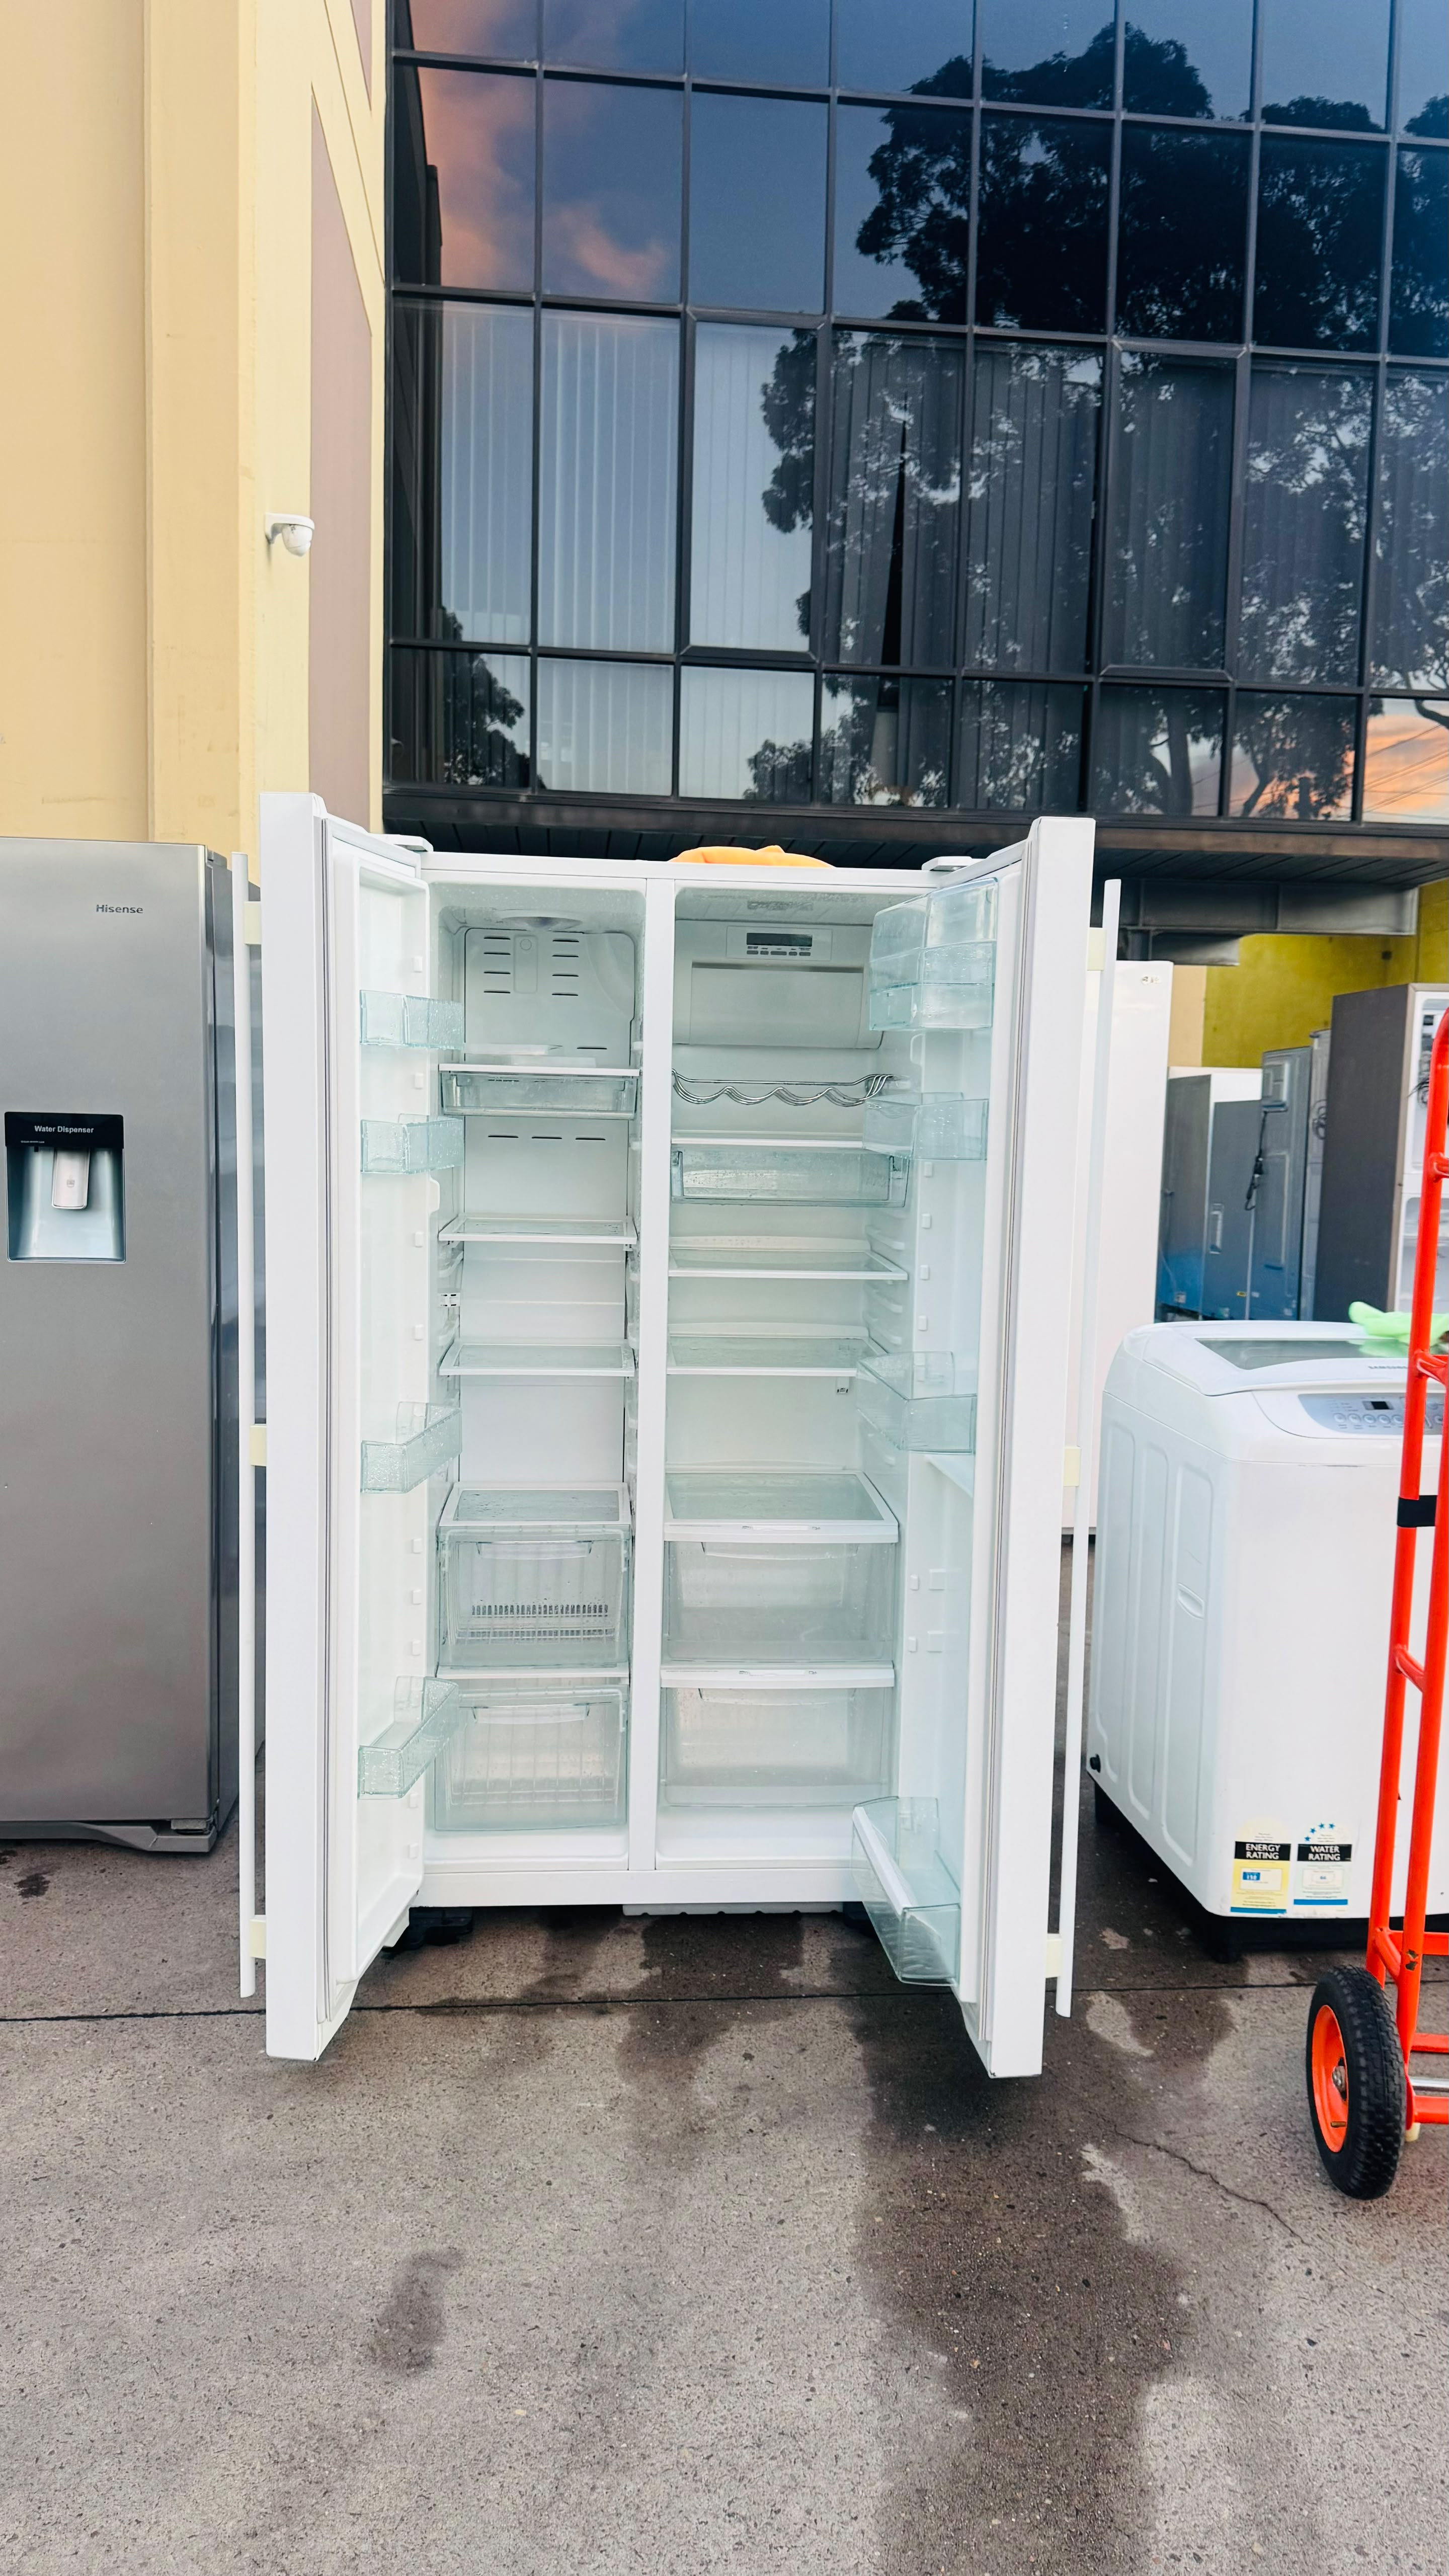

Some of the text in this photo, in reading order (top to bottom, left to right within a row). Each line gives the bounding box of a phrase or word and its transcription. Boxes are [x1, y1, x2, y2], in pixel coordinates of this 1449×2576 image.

[96, 904, 143, 914] Hisense
[57, 1125, 94, 1134] Dispenser
[1245, 1843, 1281, 1852] ENERGY
[1310, 1845, 1340, 1854] WATER
[1246, 1851, 1279, 1860] RATING
[1308, 1853, 1341, 1861] RATING
